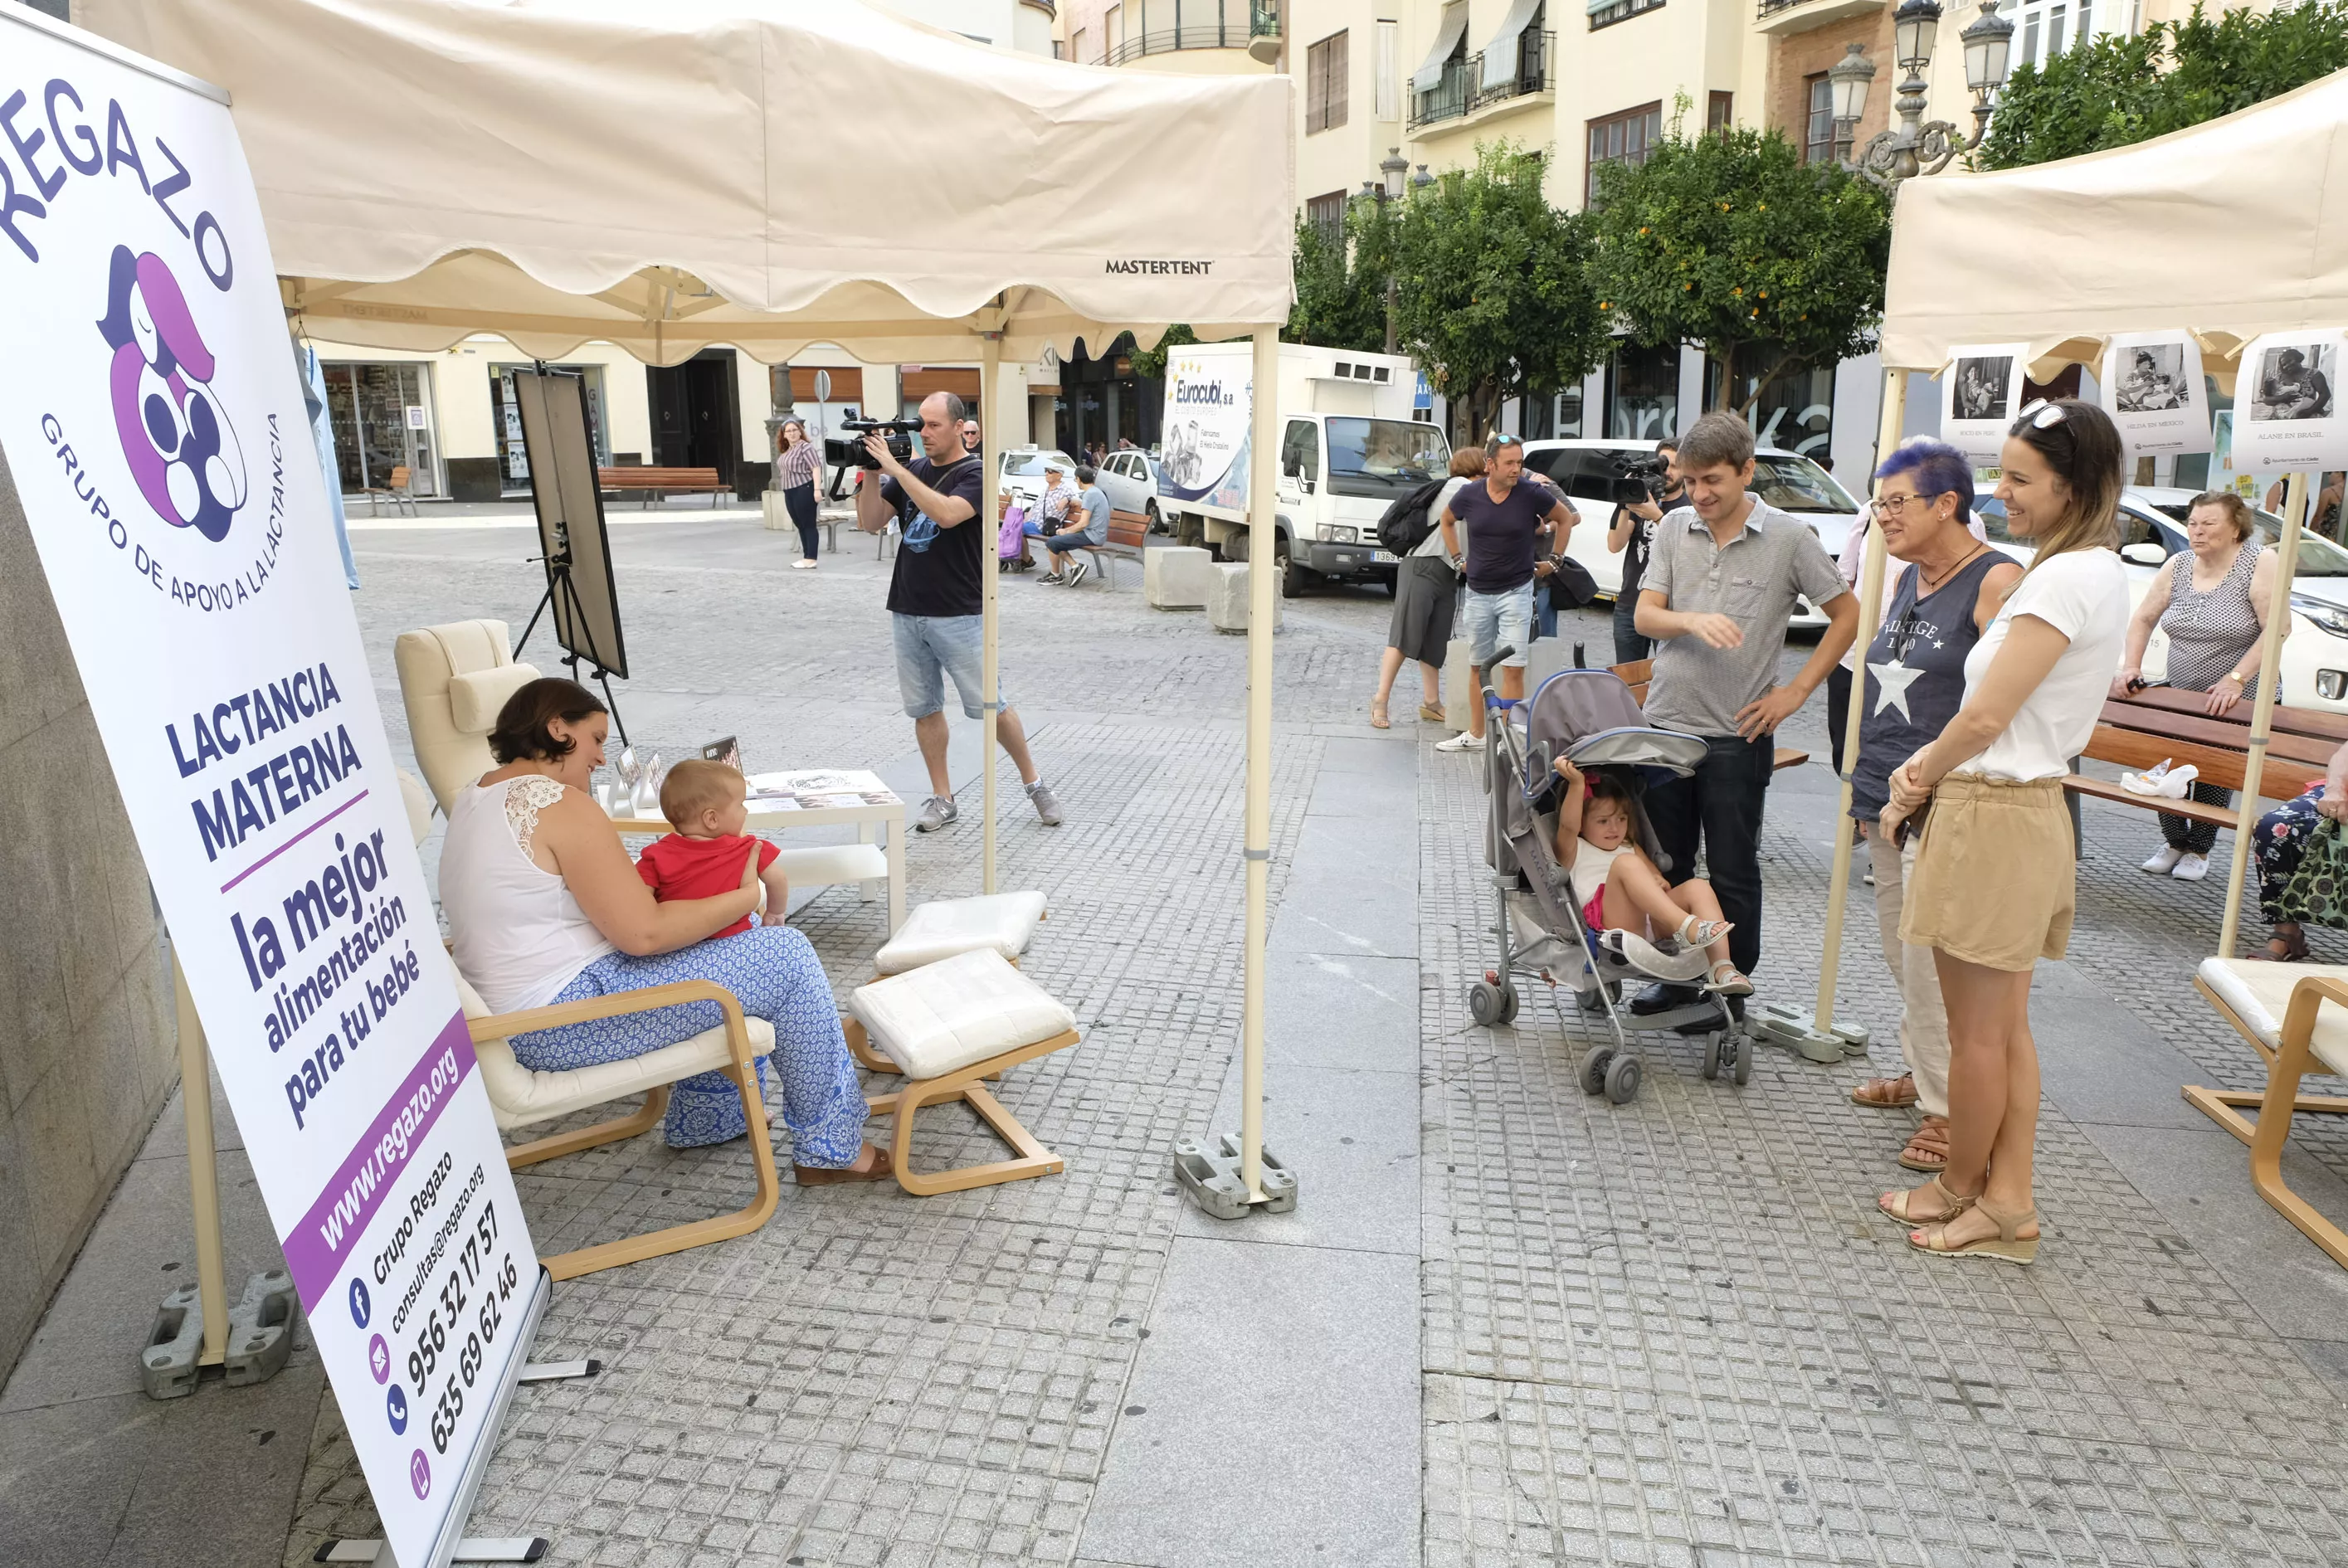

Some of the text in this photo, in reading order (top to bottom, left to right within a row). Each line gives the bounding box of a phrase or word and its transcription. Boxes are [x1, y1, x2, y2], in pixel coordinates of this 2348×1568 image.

[0, 78, 233, 292] REGAZO
[1106, 260, 1211, 275] MASTERTENT
[1176, 380, 1222, 408] Eurocubi,
[41, 413, 127, 549] GRUPO
[135, 544, 163, 591] DE
[172, 577, 232, 611] APOYO
[236, 578, 249, 605] A
[246, 560, 269, 593] LA
[263, 413, 285, 569] LACTANCIA
[165, 662, 341, 778] LACTANCIA
[191, 724, 362, 862] MATERNA
[230, 828, 387, 992] la mejor
[264, 896, 407, 1053] alimentación
[285, 939, 420, 1131] para tu bebé
[320, 1046, 459, 1252] www.regazo.org
[374, 1152, 452, 1285] Grupo Regazo
[392, 1162, 485, 1334] consultas@regazo.org
[407, 1200, 499, 1397] 956 32 17 57
[431, 1253, 519, 1455] 635 69 62 46
